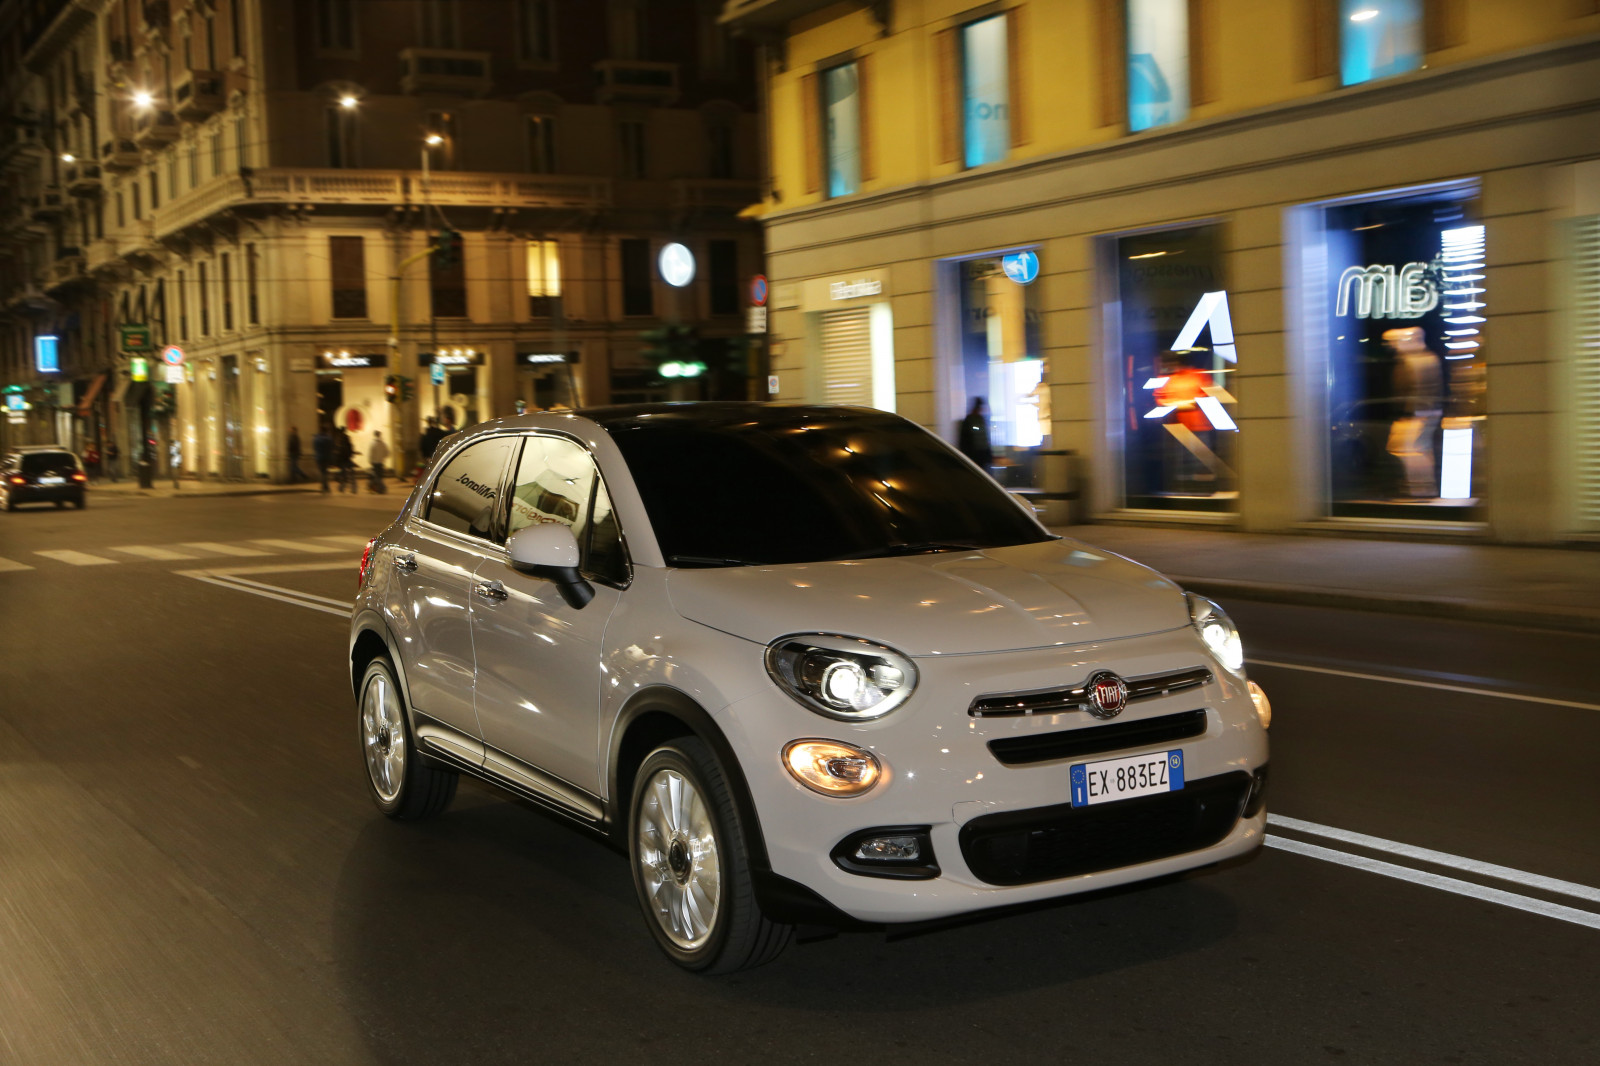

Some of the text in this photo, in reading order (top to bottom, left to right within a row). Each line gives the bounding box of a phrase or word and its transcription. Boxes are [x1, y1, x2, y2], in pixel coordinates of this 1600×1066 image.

[1100, 685, 1118, 704] FIAT
[1088, 770, 1109, 797] EX
[1116, 761, 1168, 791] 883EZ
[1171, 757, 1179, 765] 14
